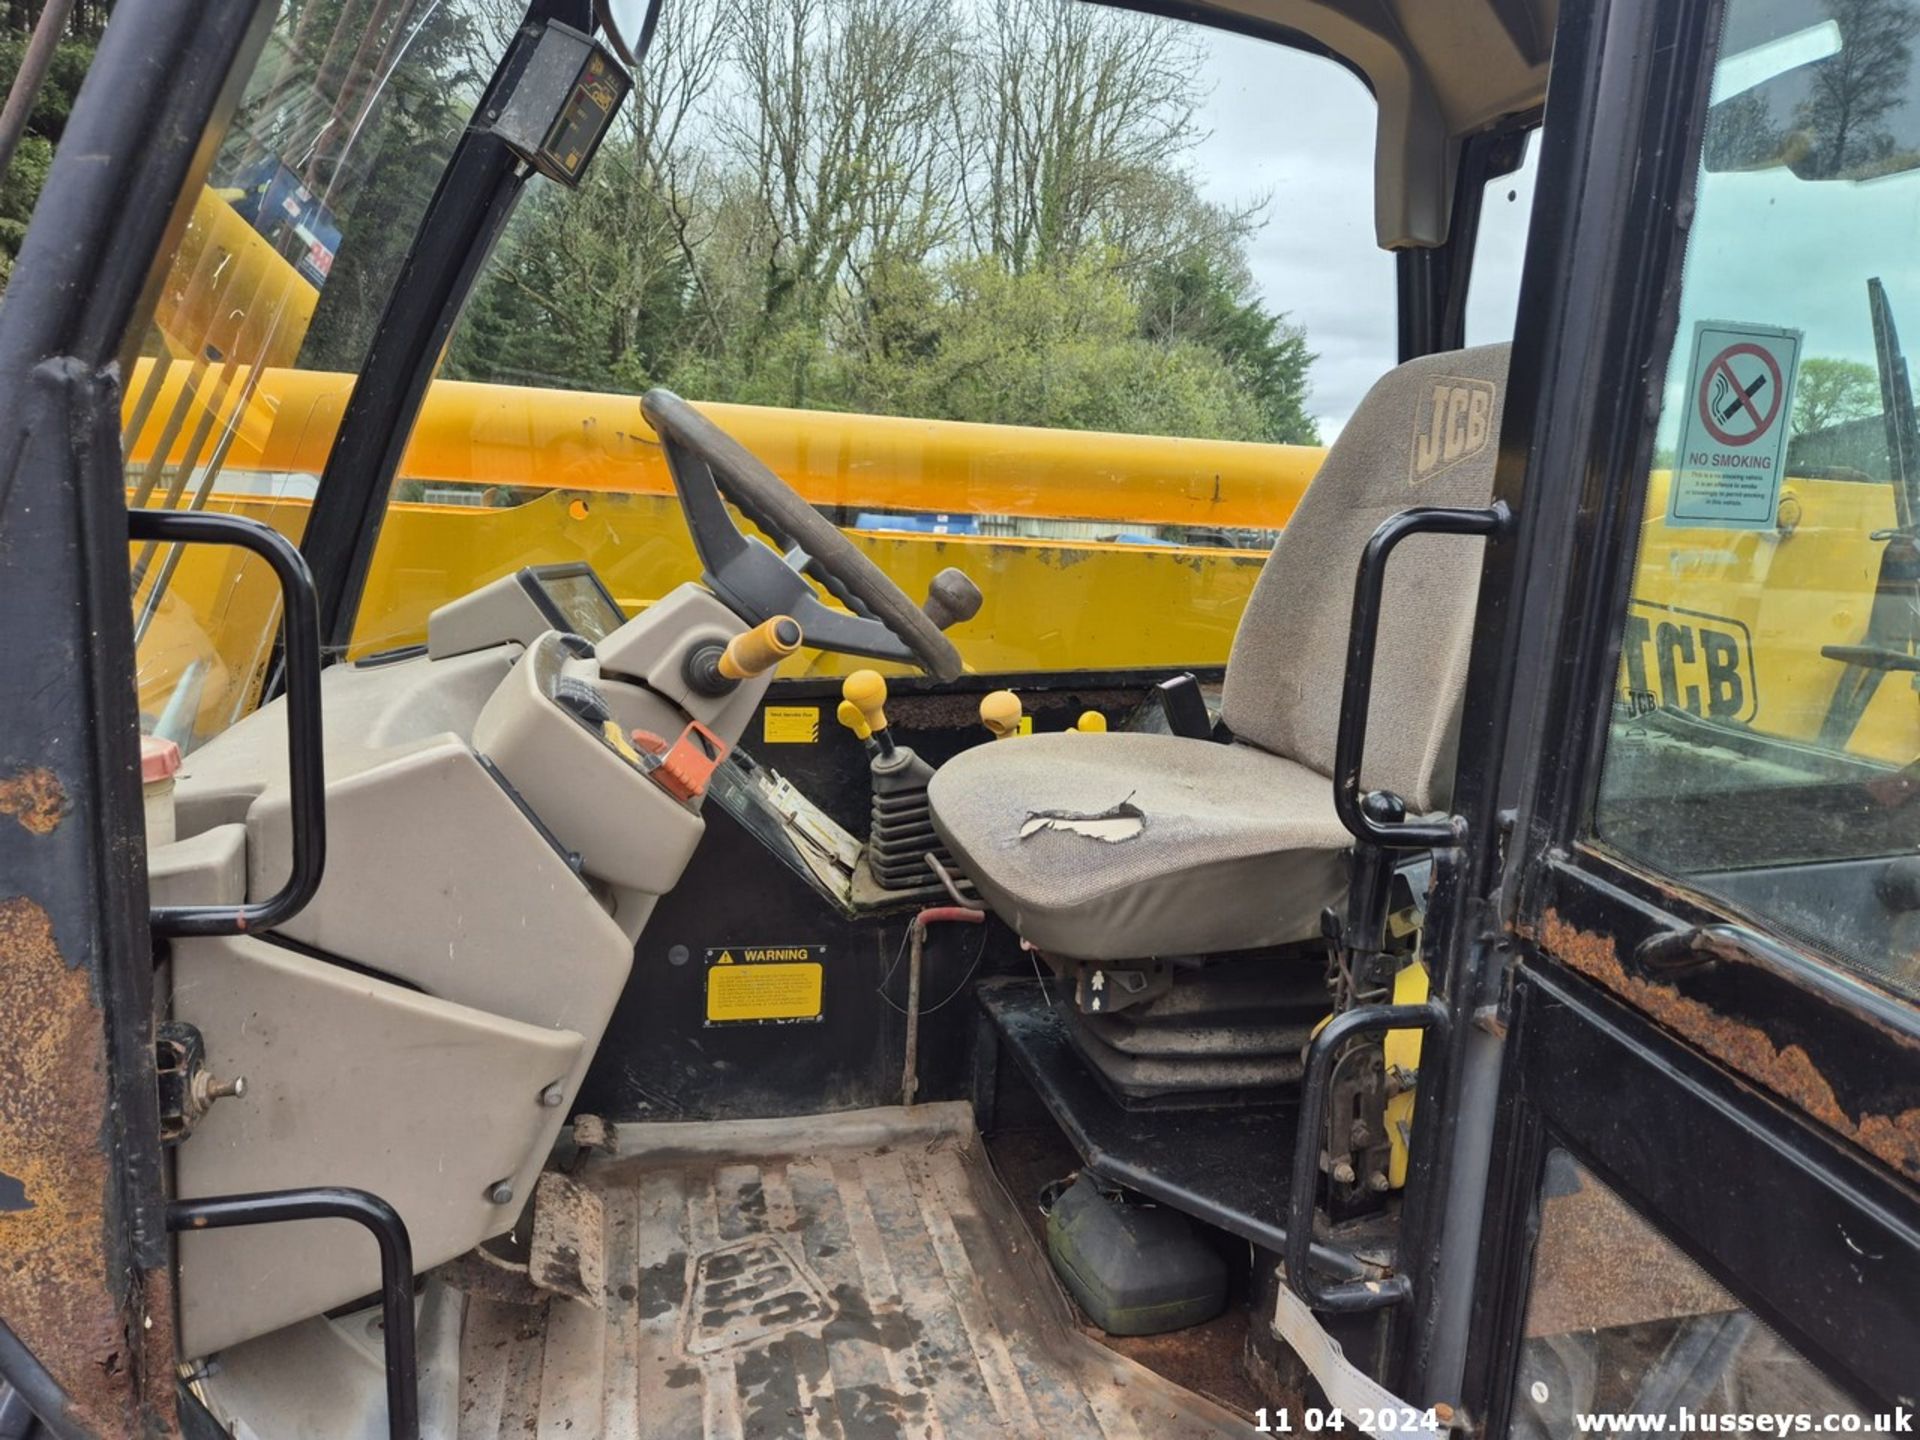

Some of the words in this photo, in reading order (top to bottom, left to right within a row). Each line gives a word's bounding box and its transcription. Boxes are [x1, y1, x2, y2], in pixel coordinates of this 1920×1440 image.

[1417, 385, 1488, 473] JCB
[1689, 452, 1708, 466] NO
[1712, 454, 1771, 469] SMOKING
[1628, 690, 1656, 717] JCB
[744, 949, 808, 962] WARNING
